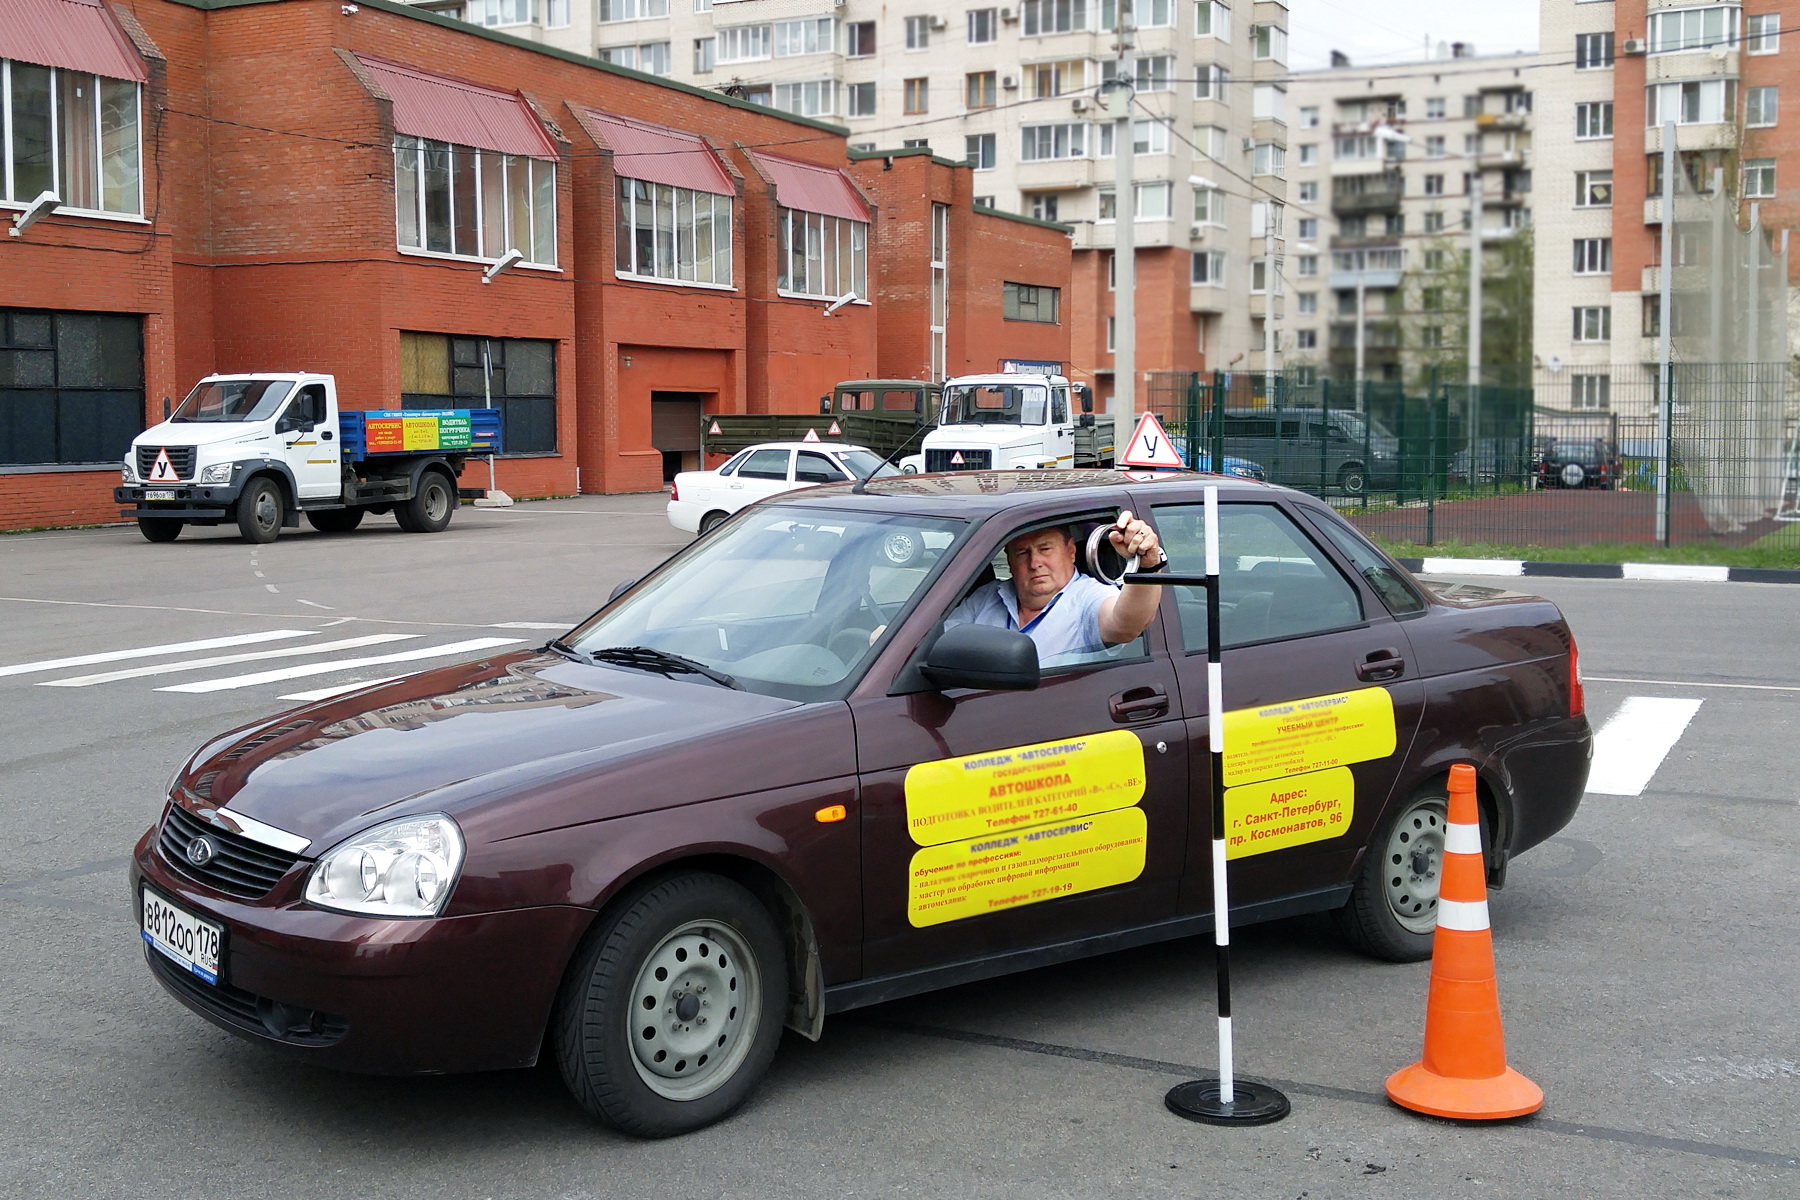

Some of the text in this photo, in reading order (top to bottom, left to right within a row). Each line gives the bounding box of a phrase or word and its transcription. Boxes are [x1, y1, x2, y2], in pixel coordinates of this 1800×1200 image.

[1143, 435, 1158, 458] У
[158, 462, 167, 478] У
[1277, 716, 1339, 735] УЧЕБНЫЙ ЦЕНТР
[964, 755, 1013, 770] КОЛЛЕДЖ
[993, 759, 1066, 778] ГОСУДАРСТВЕННАЯ
[1284, 758, 1339, 774] Телефон 727-11-00
[989, 773, 1072, 798] АВТОШКОЛА
[1270, 788, 1308, 804] Адрес:
[913, 809, 976, 828] ПОДГОТОВКА
[986, 803, 1078, 828] Телефон 727-61-40
[1233, 798, 1342, 828] г. Санкт-Петербург,
[1230, 812, 1343, 847] пр. Космонавтов, 96
[970, 836, 1019, 853] КОЛЛЕДЖ
[914, 851, 1022, 877] обучение по профессиям:
[919, 860, 1080, 900] мастер по обработке цифровой информации
[988, 882, 1073, 908] Телефон 727-19-19
[196, 924, 218, 959] 178
[201, 953, 213, 967] RUS
